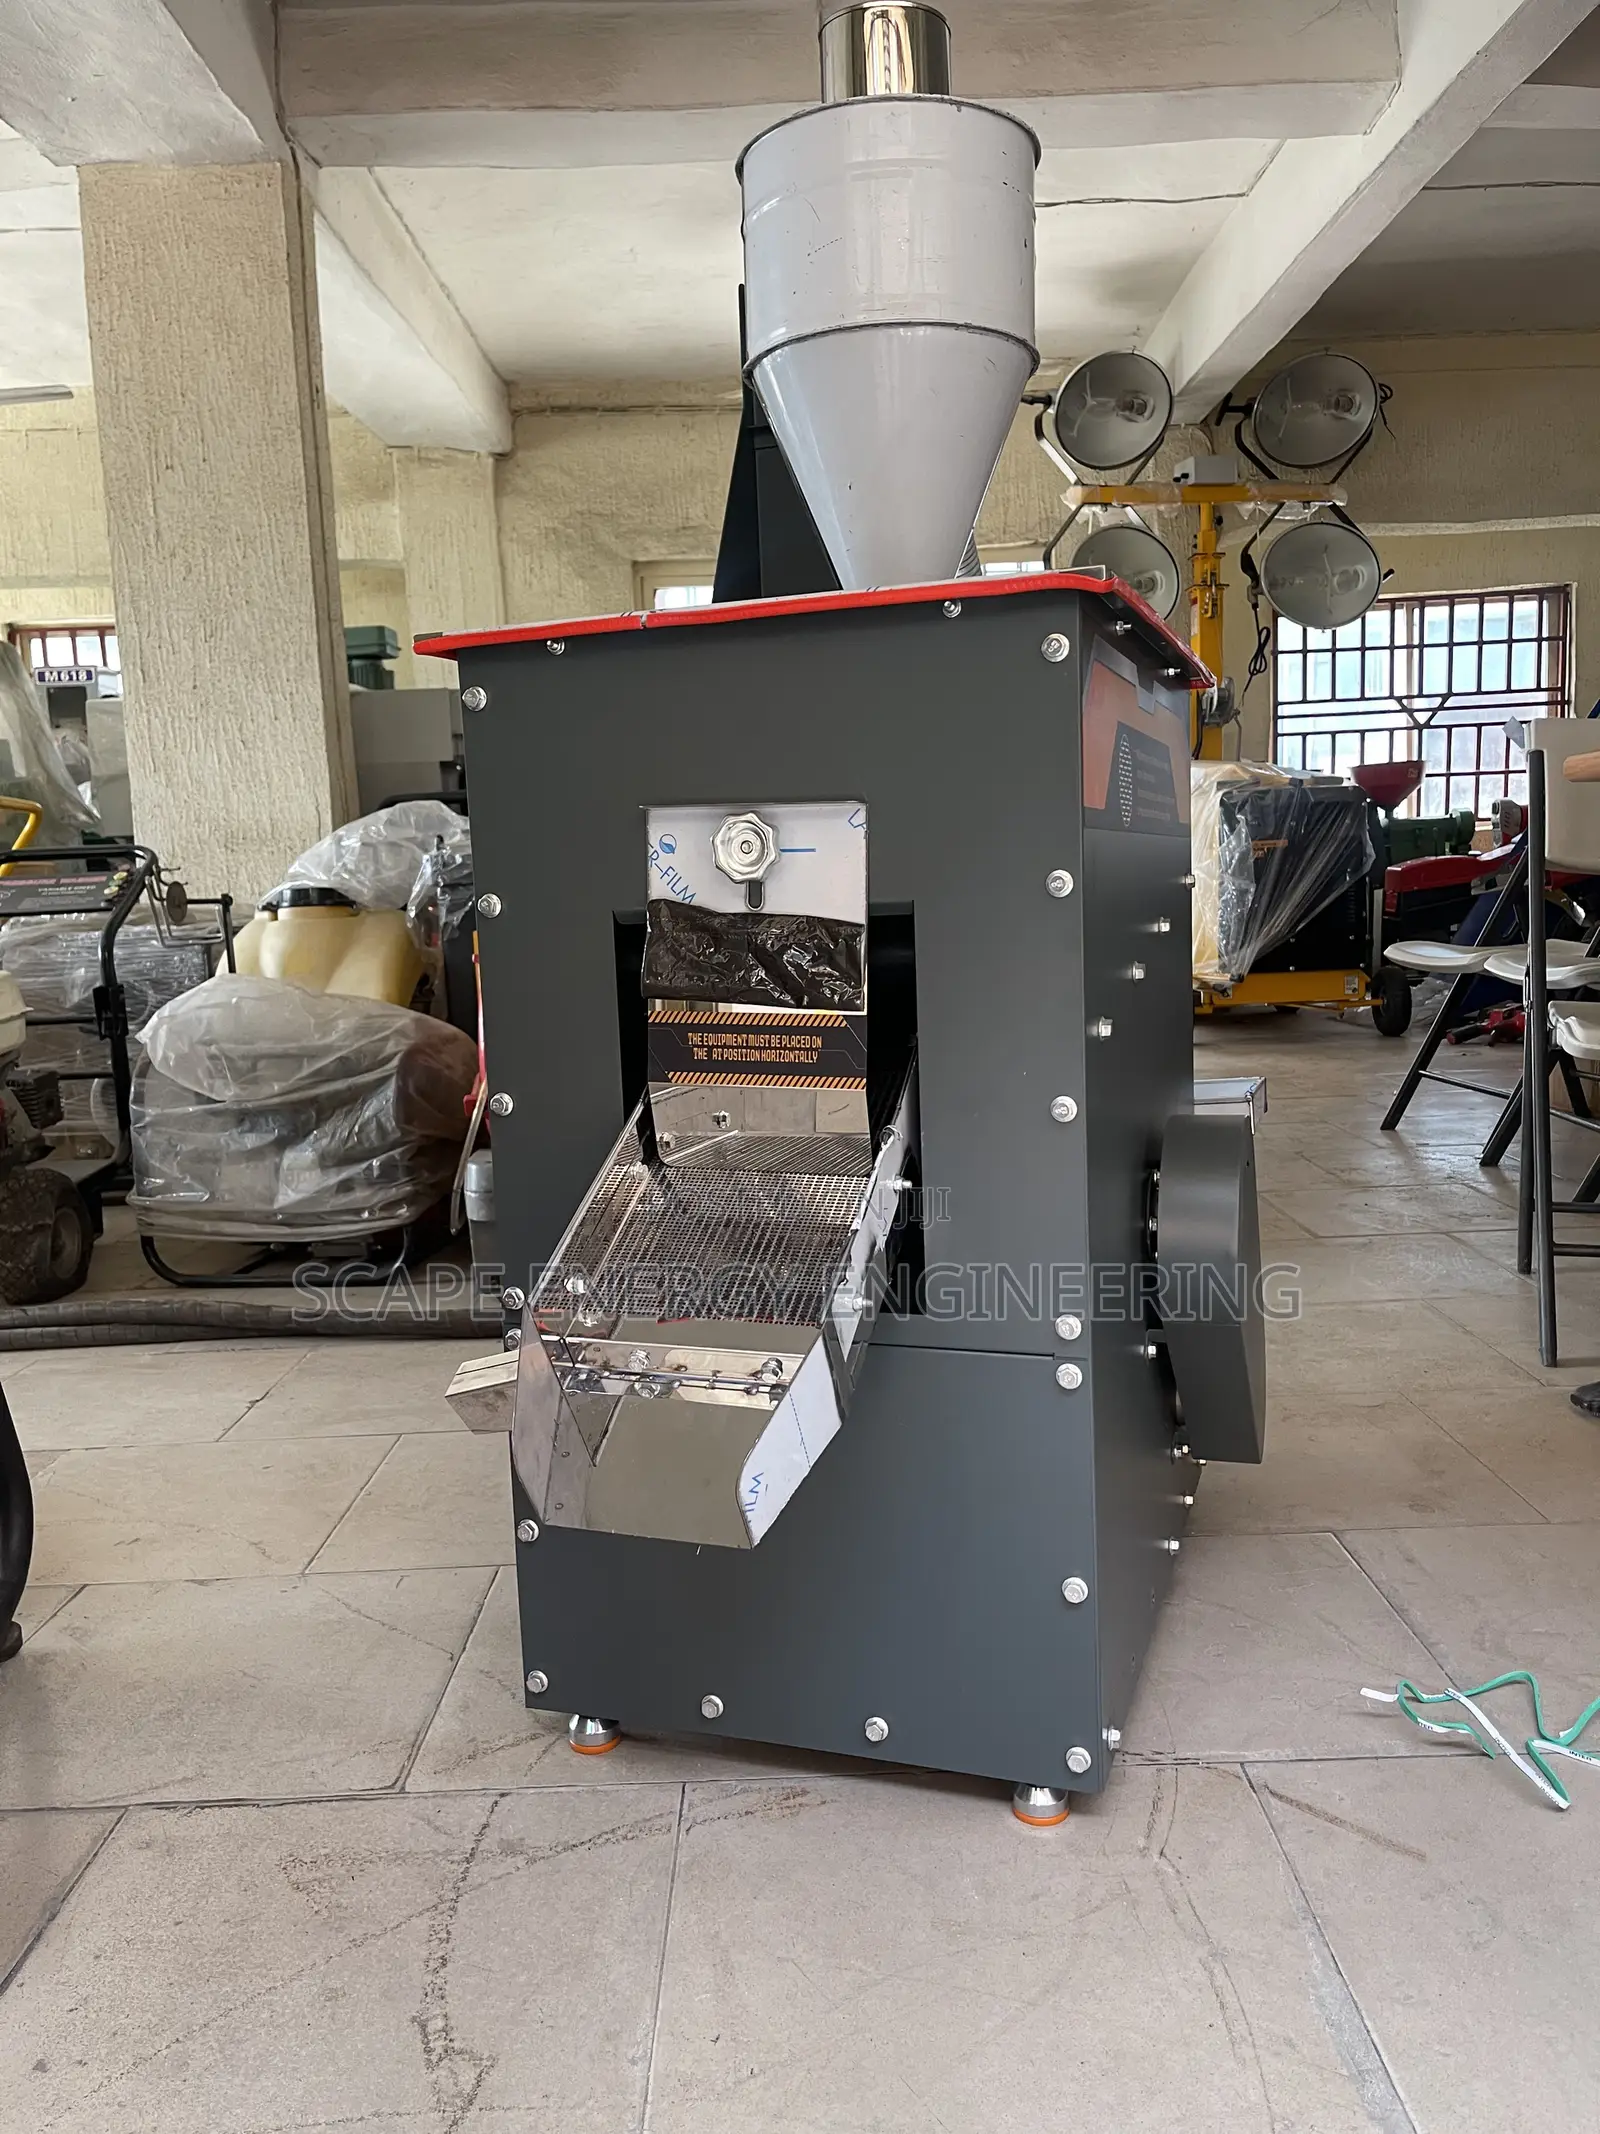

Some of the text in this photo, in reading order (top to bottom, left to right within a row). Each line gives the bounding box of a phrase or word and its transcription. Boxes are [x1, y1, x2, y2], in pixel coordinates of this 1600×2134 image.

[45, 669, 87, 683] M618
[688, 1033, 823, 1049] THE EQUIPMENT MUST BE PLACED ON
[693, 1047, 819, 1064] THE AT POSITION HORIZONTALLY
[1568, 1750, 1593, 1762] INTER
